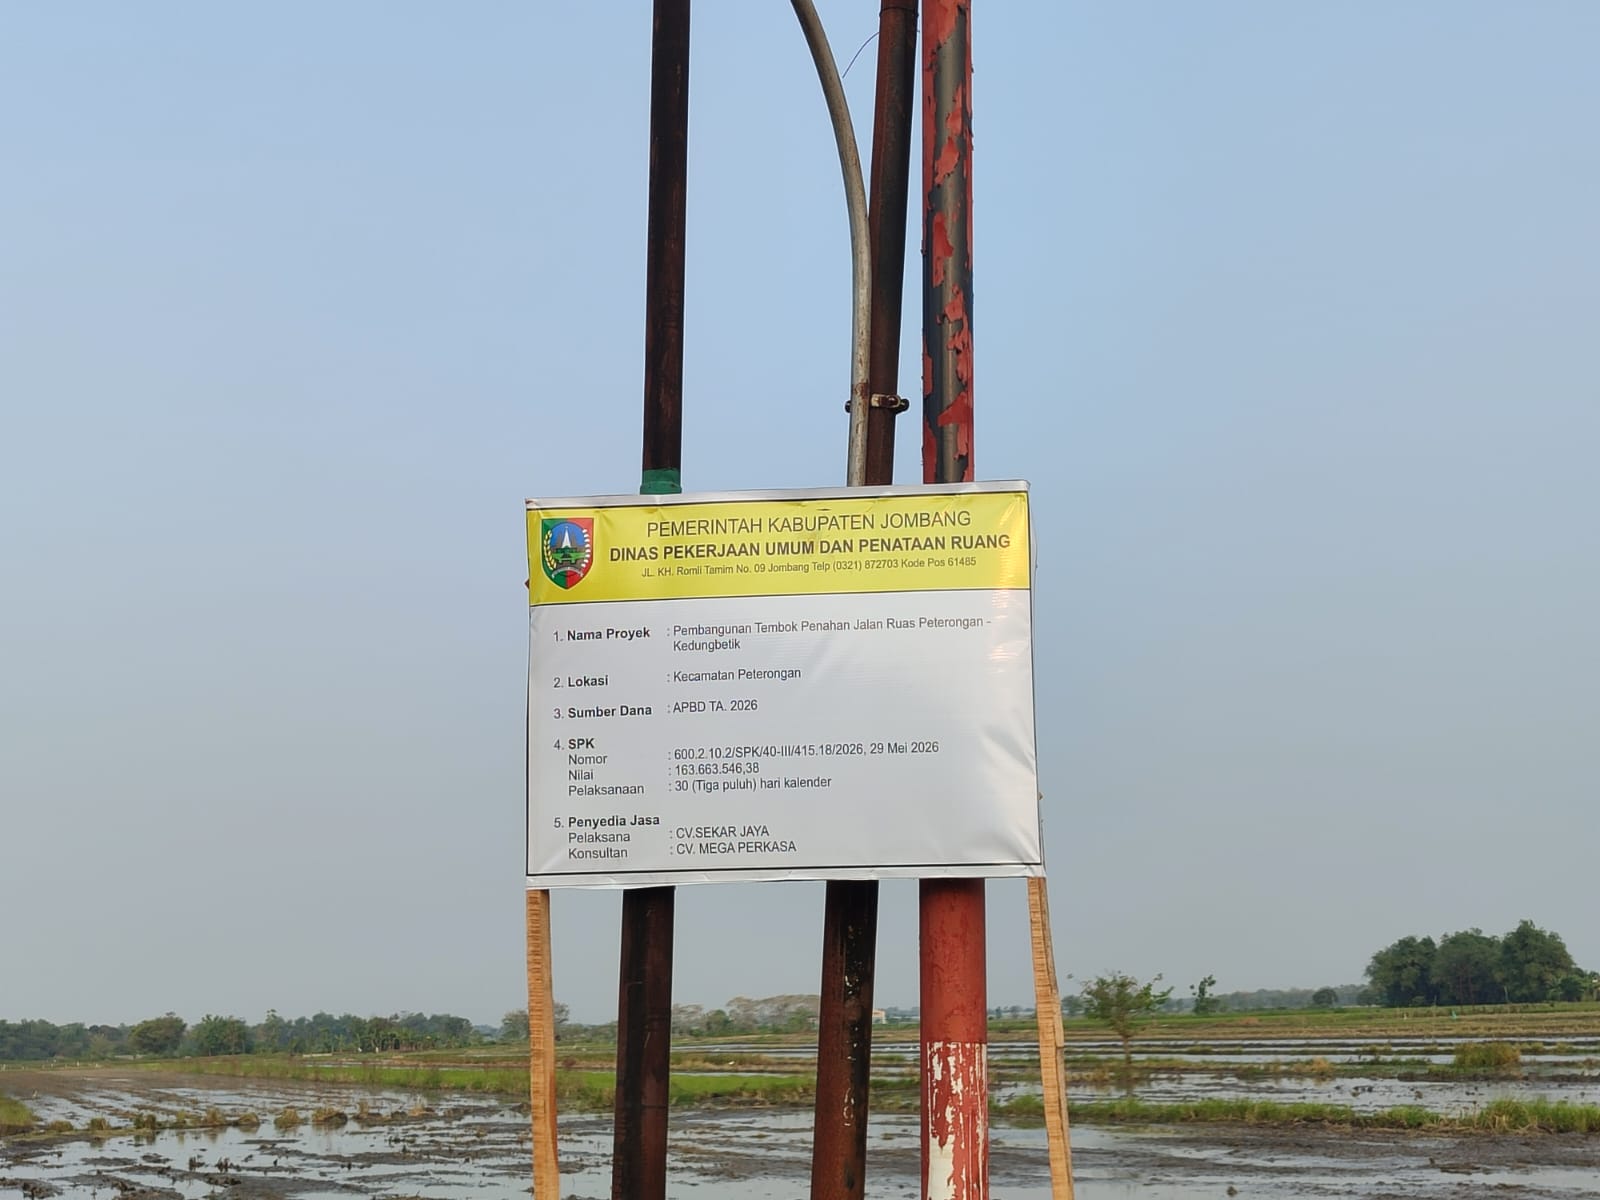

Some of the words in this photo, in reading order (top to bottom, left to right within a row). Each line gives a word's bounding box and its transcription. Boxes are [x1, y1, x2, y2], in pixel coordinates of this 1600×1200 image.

[647, 518, 762, 537] PEMERINTAH
[768, 514, 875, 533] KABUPATEN
[881, 511, 971, 529] JOMBANG
[610, 546, 658, 561] DINAS
[663, 542, 760, 559] PEKERJAAN
[766, 540, 814, 556] UMUM
[819, 539, 853, 554] DAN
[859, 536, 945, 553] PENATAAN
[951, 534, 1011, 550] RUANG
[641, 567, 654, 577] JL.
[657, 566, 674, 577] KH.
[677, 565, 702, 576] Romli
[704, 564, 733, 575] Tamim
[736, 564, 751, 574] No.
[754, 563, 765, 573] 09
[768, 561, 809, 573] Jombang
[812, 561, 830, 572] Telp
[833, 560, 862, 572] (0321)
[864, 558, 899, 569] 872703
[901, 558, 925, 568] Kode
[927, 557, 945, 568] Pos
[947, 556, 976, 567] 61485
[553, 631, 564, 642] 1.
[567, 629, 603, 641] Nama
[606, 627, 651, 640] Proyek
[673, 623, 752, 637] Pembangunan
[754, 620, 798, 633] Tembok
[801, 620, 850, 631] Penahan
[853, 619, 883, 630] Jalan
[886, 618, 915, 629] Ruas
[919, 617, 983, 630] Peterongan
[673, 639, 741, 652] Kedungbetik
[553, 677, 564, 688] 2.
[567, 674, 608, 688] Lokasi
[673, 670, 734, 682] Kecamatan
[738, 668, 801, 681] Peterongan
[553, 708, 564, 719] 3.
[567, 706, 616, 719] Sumber
[620, 705, 652, 716] Dana
[673, 701, 706, 713] APBD
[709, 701, 727, 712] TA.
[730, 699, 758, 711] 2026
[553, 739, 564, 751] 4.
[568, 738, 595, 750] SPK
[568, 754, 608, 765] Nomor
[674, 744, 867, 760] 600.2.10.2/SPK/40-III/415.18/2026,
[870, 743, 884, 754] 29
[887, 742, 908, 754] Mei
[911, 741, 939, 753] 2026
[568, 769, 594, 781] Nilai
[675, 762, 759, 776] 163.663.546,38
[568, 784, 645, 796] Pelaksanaan
[674, 780, 689, 792] 30
[691, 779, 719, 793] (Tiga
[723, 778, 757, 793] puluh)
[760, 777, 781, 789] hari
[784, 776, 832, 788] kalender
[553, 817, 564, 828] 5.
[568, 815, 626, 830] Penyedia
[629, 814, 660, 826] Jasa
[568, 831, 631, 844] Pelaksana
[739, 825, 769, 837] JAYA
[568, 848, 628, 860] Konsultan
[676, 843, 696, 855] CV.
[699, 842, 735, 854] MEGA
[738, 841, 797, 853] PERKASA
